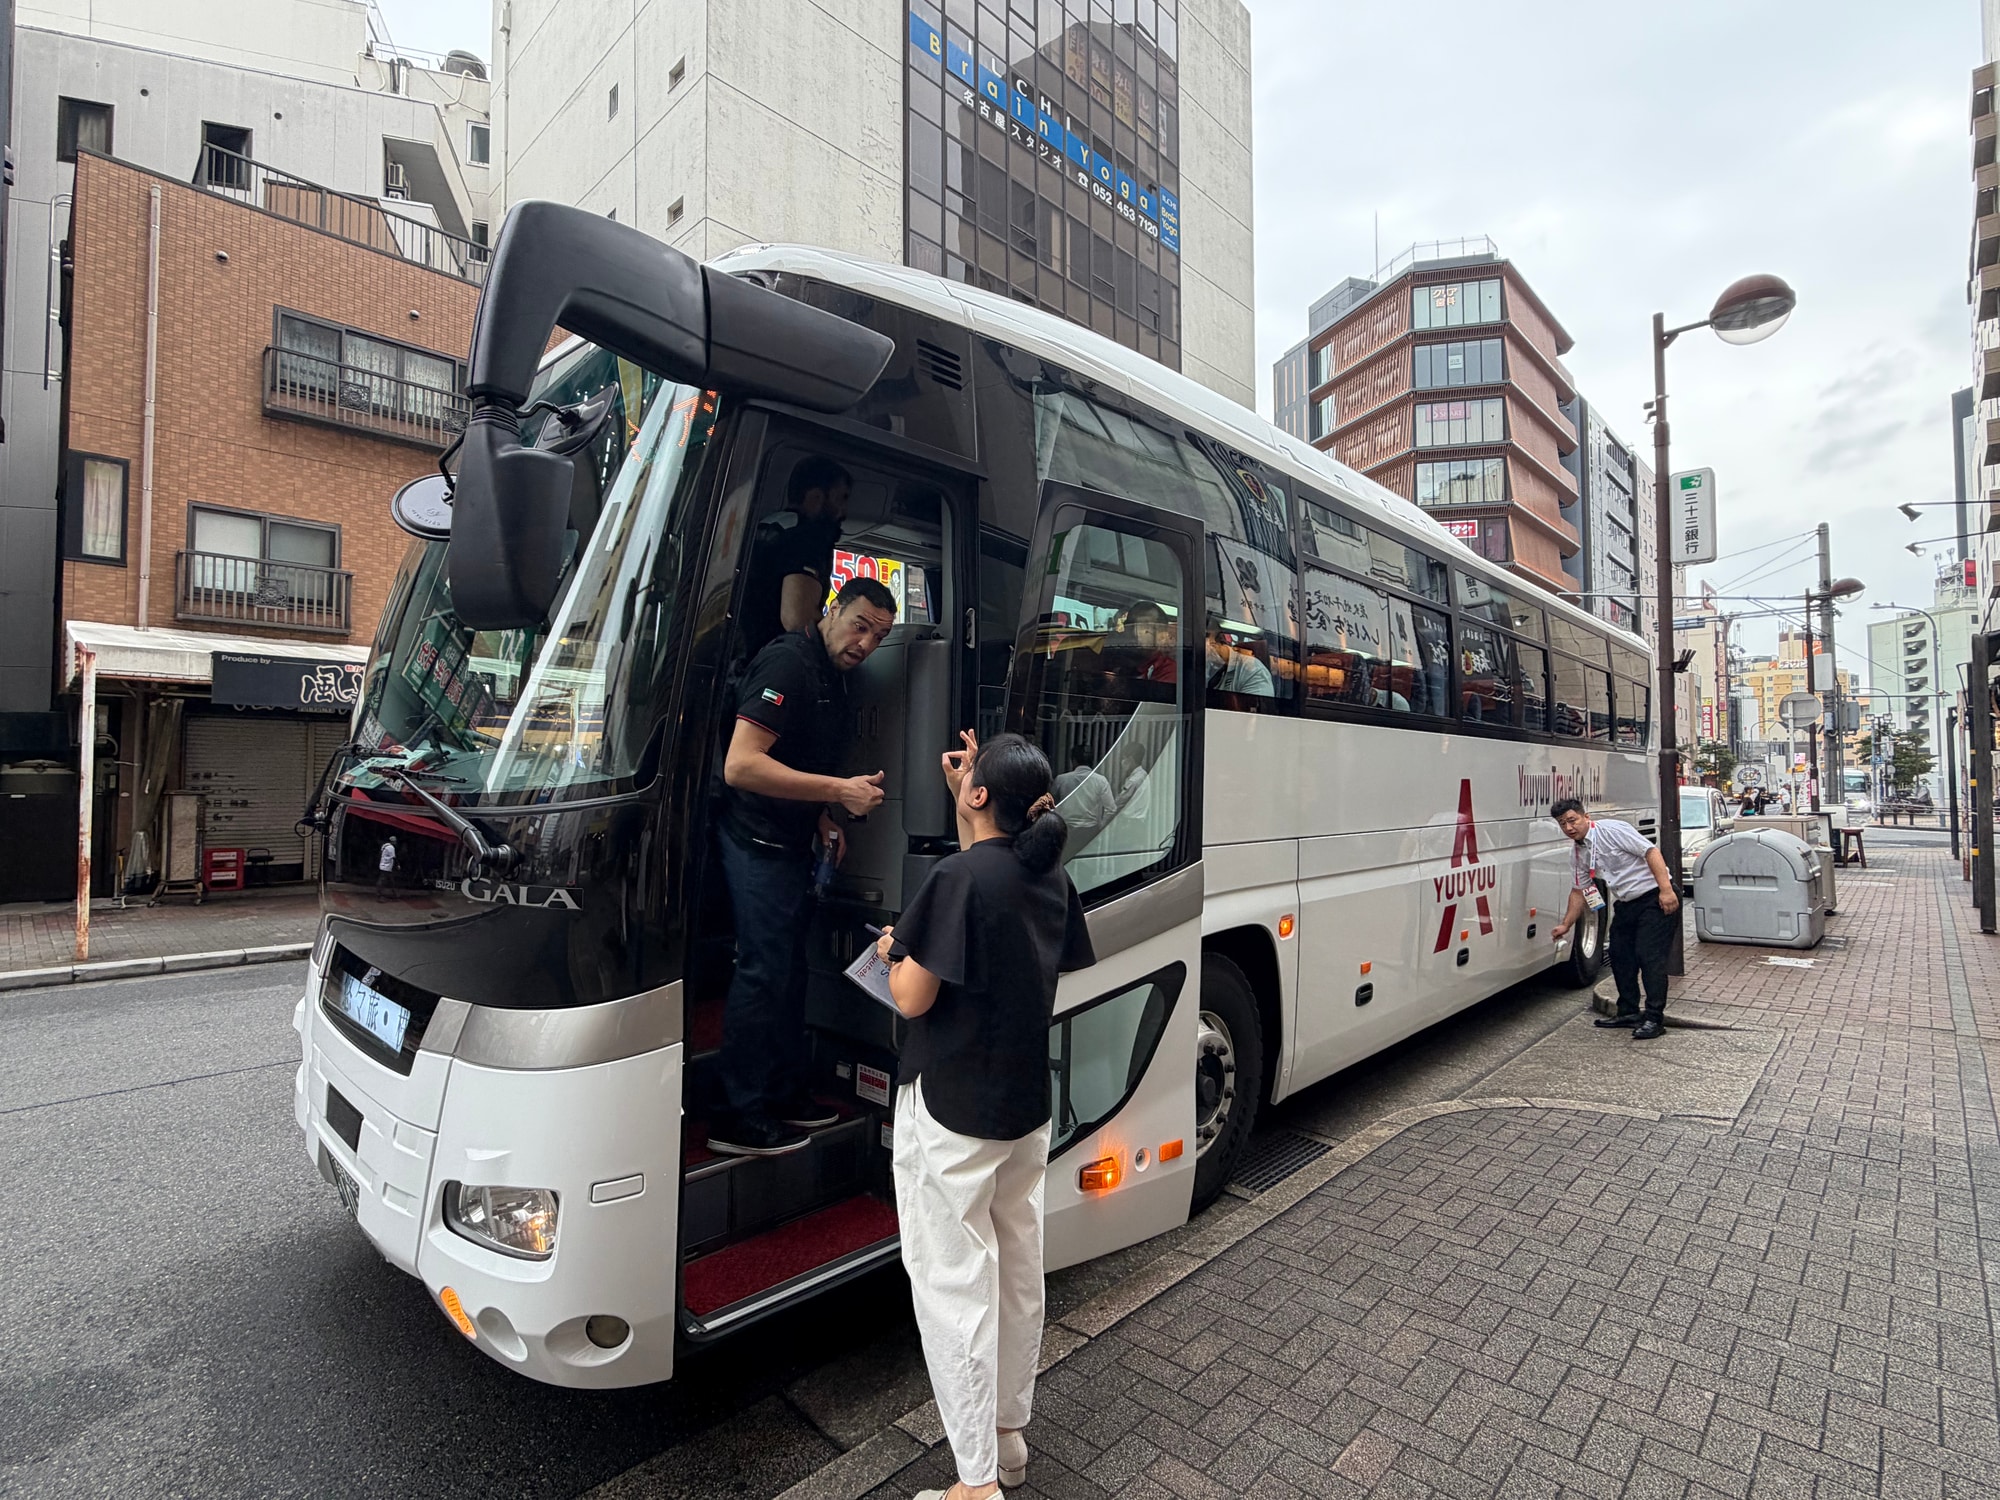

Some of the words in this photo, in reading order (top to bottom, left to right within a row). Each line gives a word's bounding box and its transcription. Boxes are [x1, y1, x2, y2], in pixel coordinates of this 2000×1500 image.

[929, 32, 1048, 137] Brain
[1080, 145, 1148, 210] Yoga
[963, 89, 1062, 168] 名古屋スタジオ
[1093, 182, 1112, 205] 052
[1117, 200, 1136, 221] 453
[1138, 214, 1158, 238] 7120
[1161, 206, 1178, 226] Brain
[1162, 218, 1178, 237] Yoga
[1433, 287, 1457, 299] クリア
[1685, 492, 1699, 554] 三十三銀行
[221, 654, 258, 664] Produce
[1518, 764, 1550, 818] Yuuyuu
[1552, 763, 1575, 803] Travel
[1590, 765, 1602, 802] Ltd.
[435, 879, 456, 891] ISUZU
[461, 877, 581, 910] GALA
[1433, 864, 1496, 903] YUUYUU
